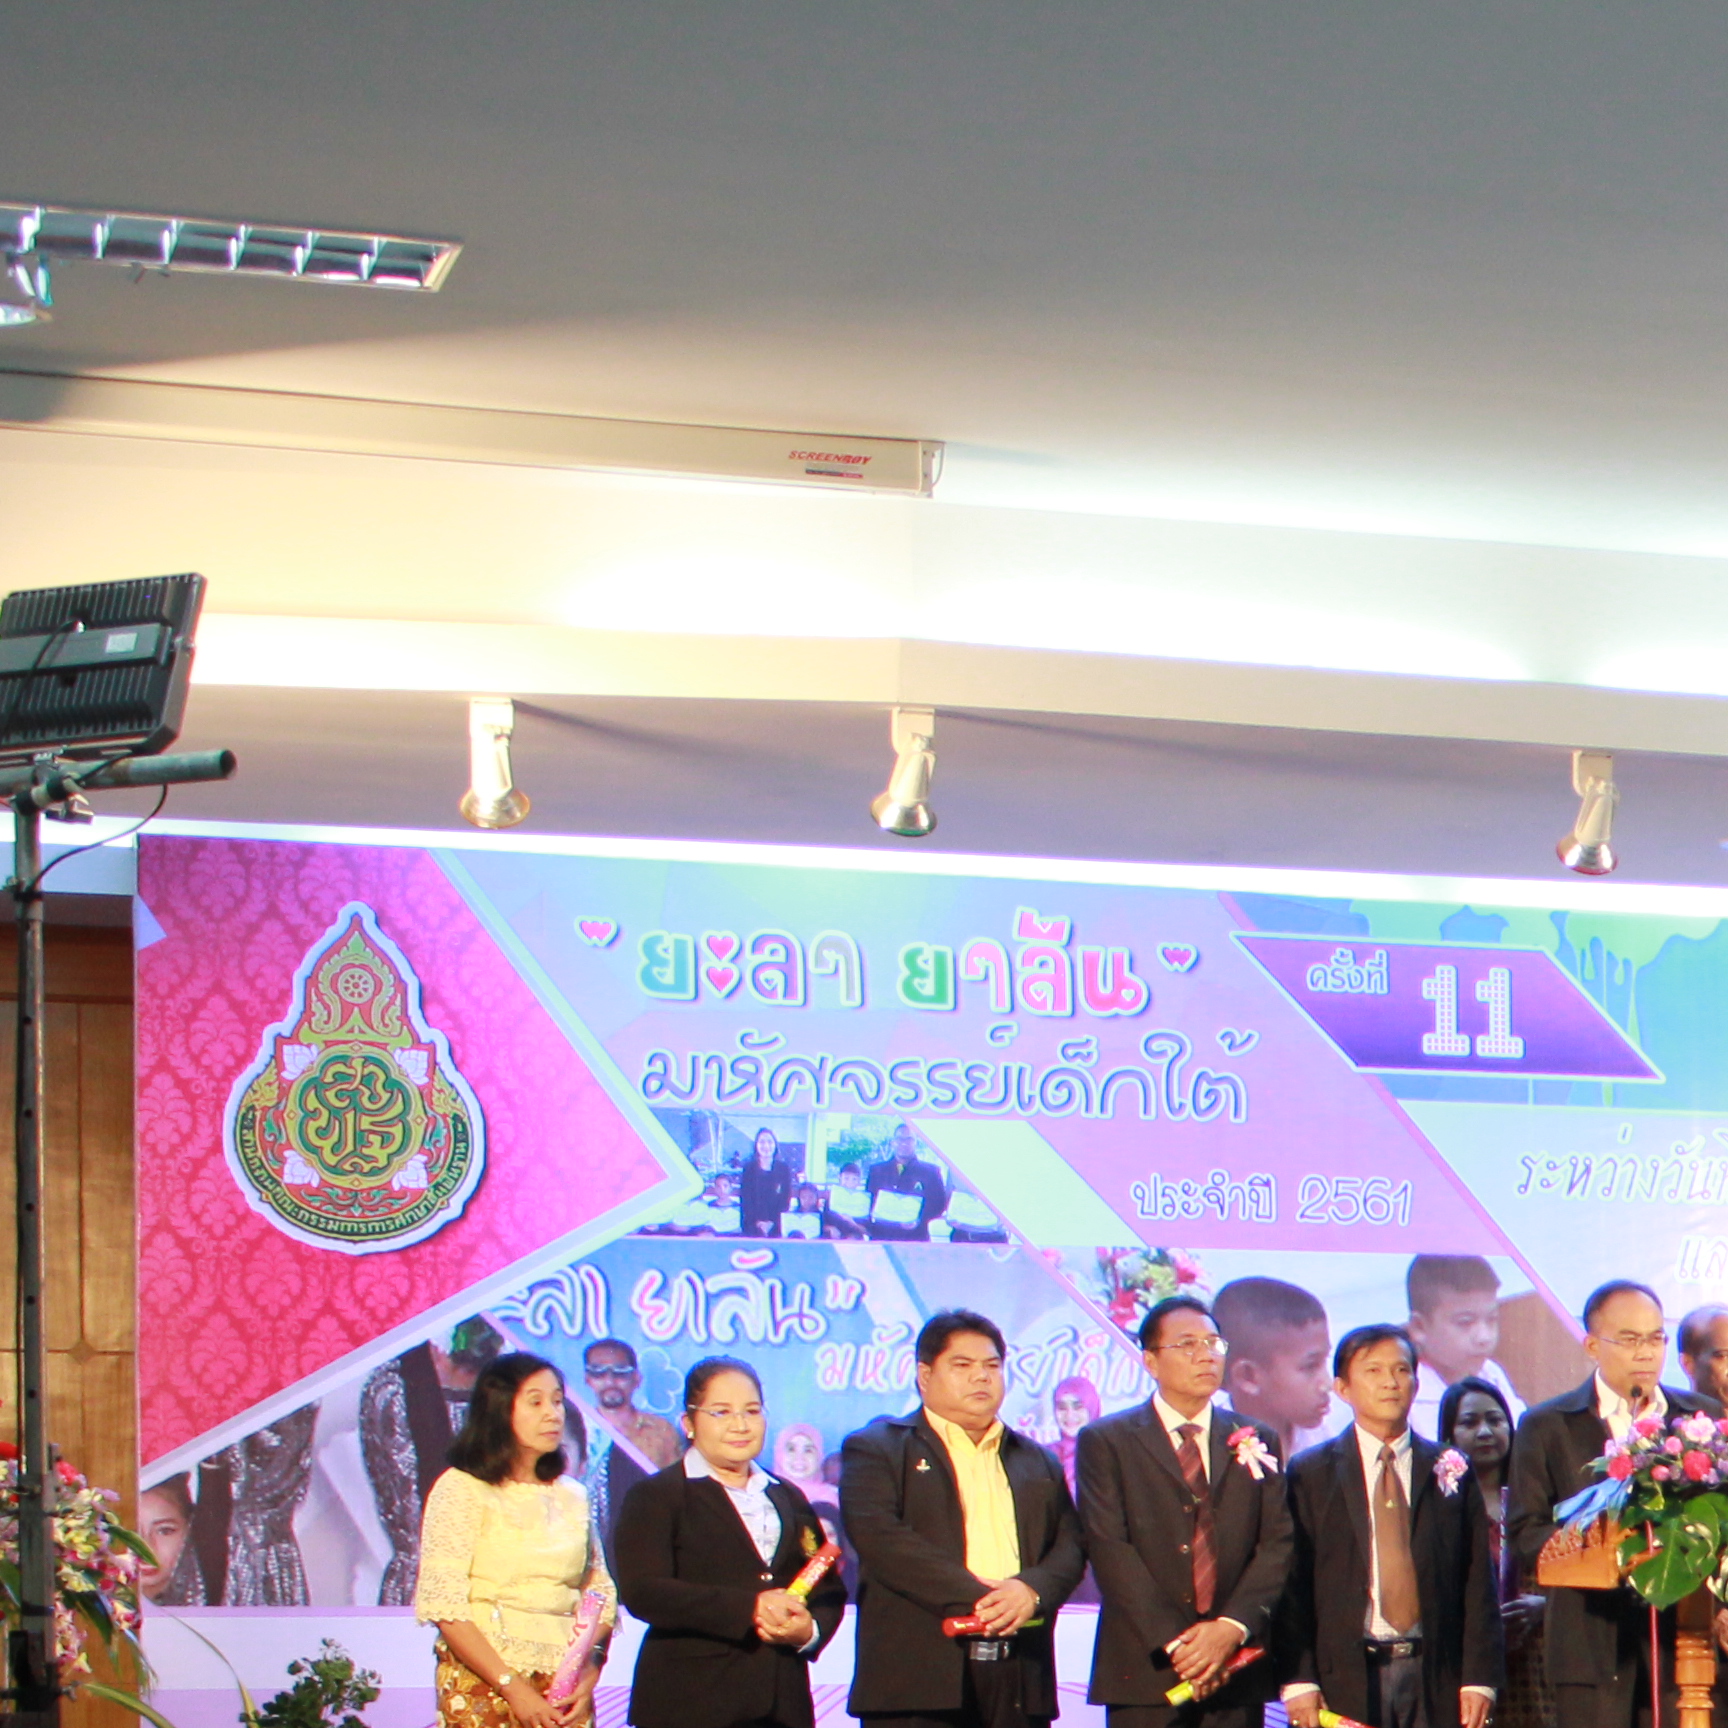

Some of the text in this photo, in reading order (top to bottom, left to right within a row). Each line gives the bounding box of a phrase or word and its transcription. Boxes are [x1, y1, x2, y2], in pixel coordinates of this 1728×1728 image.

[1306, 947, 1526, 1059] ครั้งที่ 11
[640, 1021, 1260, 1123] มหัศจรรย์เด็กใต้
[1130, 1168, 1414, 1227] ประจำปี 2561
